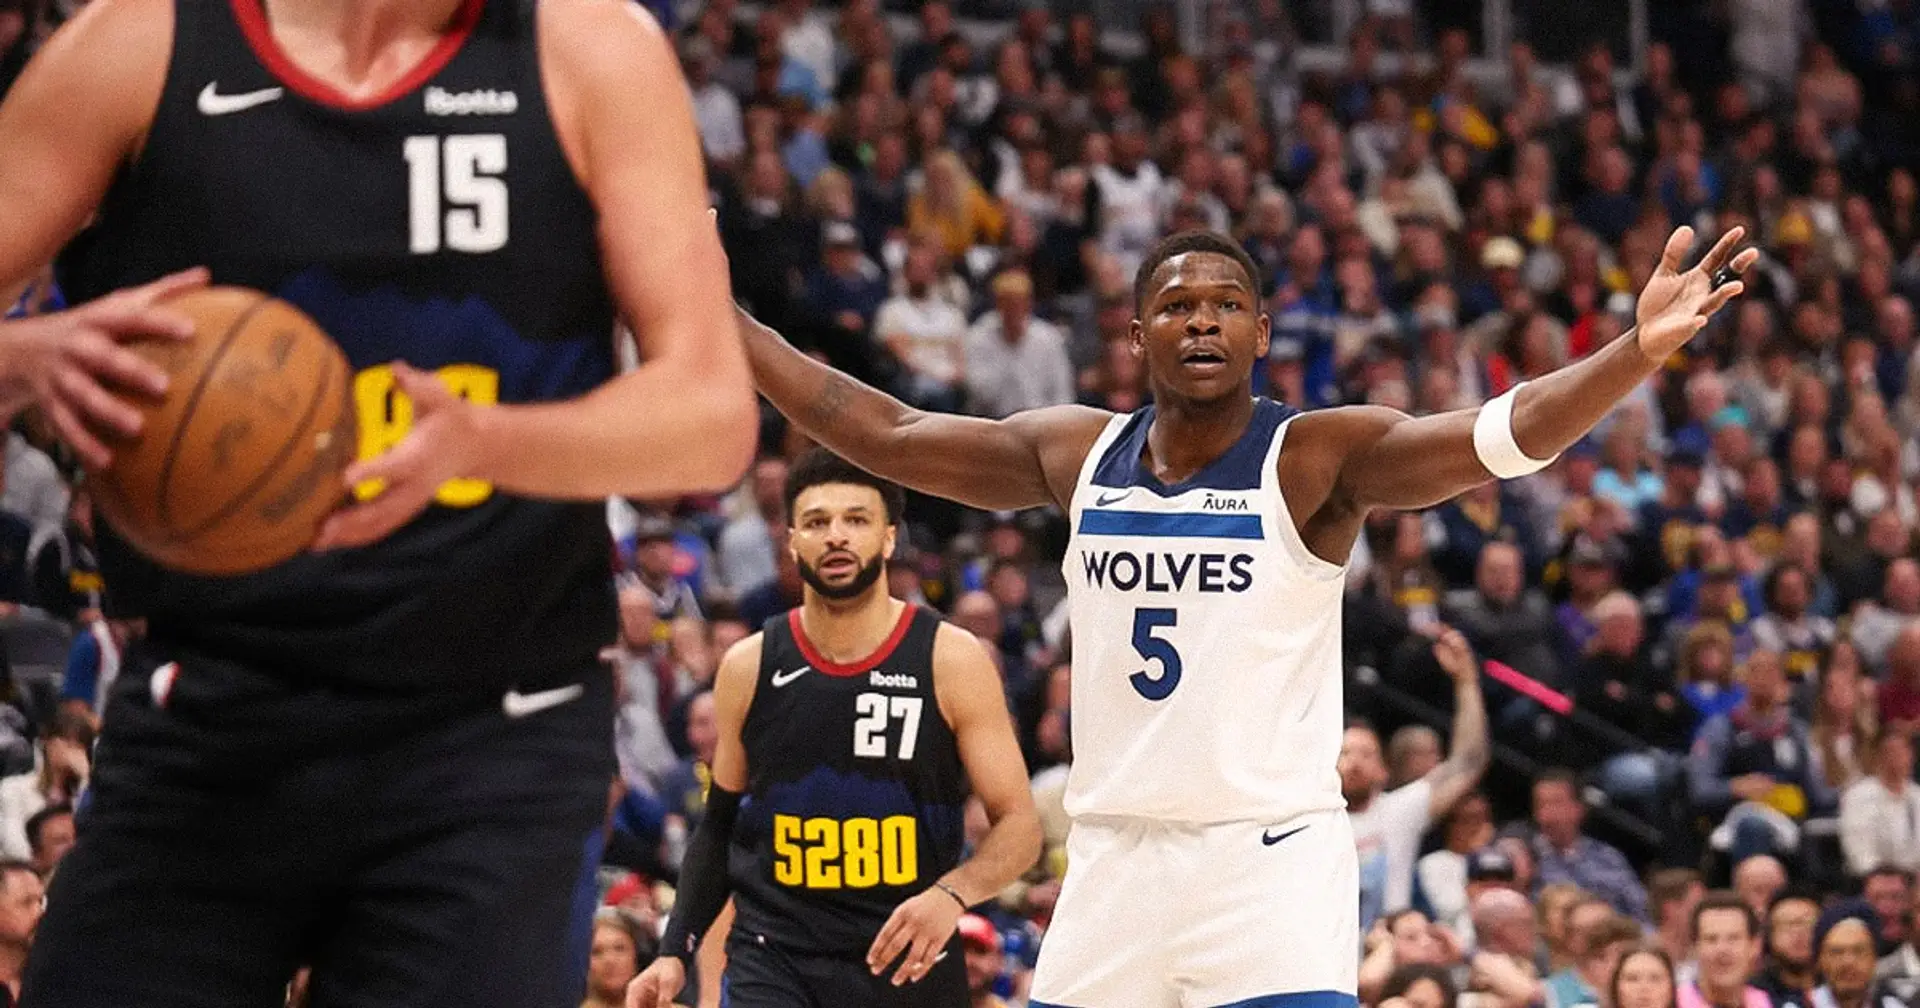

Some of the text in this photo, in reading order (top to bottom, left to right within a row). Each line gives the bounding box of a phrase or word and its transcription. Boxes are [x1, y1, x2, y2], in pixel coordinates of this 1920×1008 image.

[403, 134, 508, 253] 15
[1081, 551, 1254, 592] WOLVES
[1129, 608, 1182, 701] 5
[853, 692, 923, 760] 27
[774, 814, 918, 889] 5280
